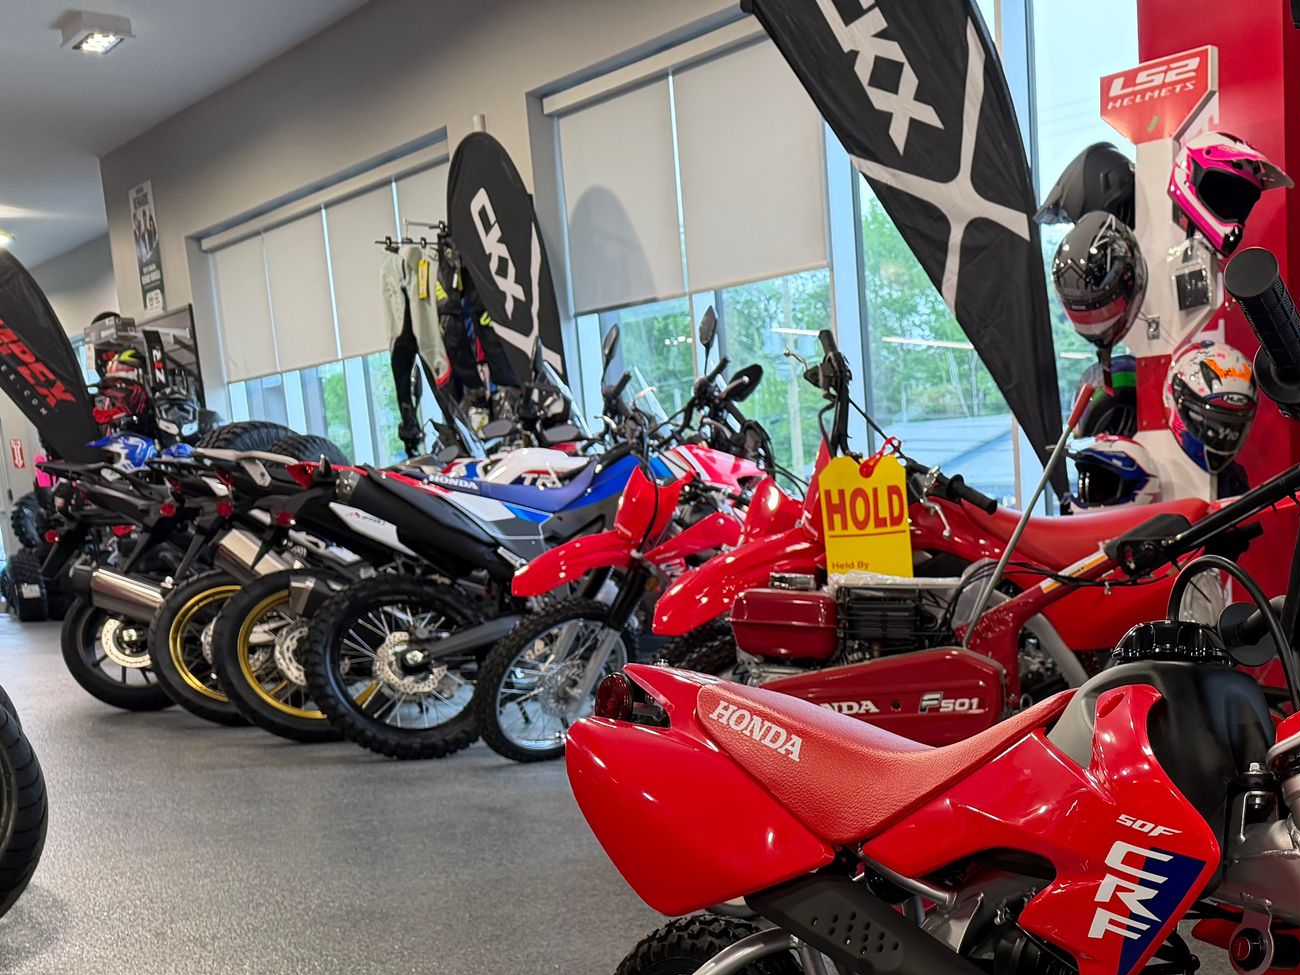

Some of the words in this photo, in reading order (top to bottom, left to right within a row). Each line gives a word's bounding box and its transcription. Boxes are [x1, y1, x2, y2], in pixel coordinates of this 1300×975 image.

[1109, 57, 1200, 97] LS2
[1107, 80, 1196, 110] HELMETS
[428, 474, 479, 491] HONDA
[824, 485, 904, 531] HOLD
[832, 561, 854, 569] Held
[857, 560, 869, 570] By
[817, 700, 880, 716] NDA
[709, 700, 804, 762] HONDA
[1116, 813, 1183, 836] 50F
[1088, 840, 1174, 940] CRF
